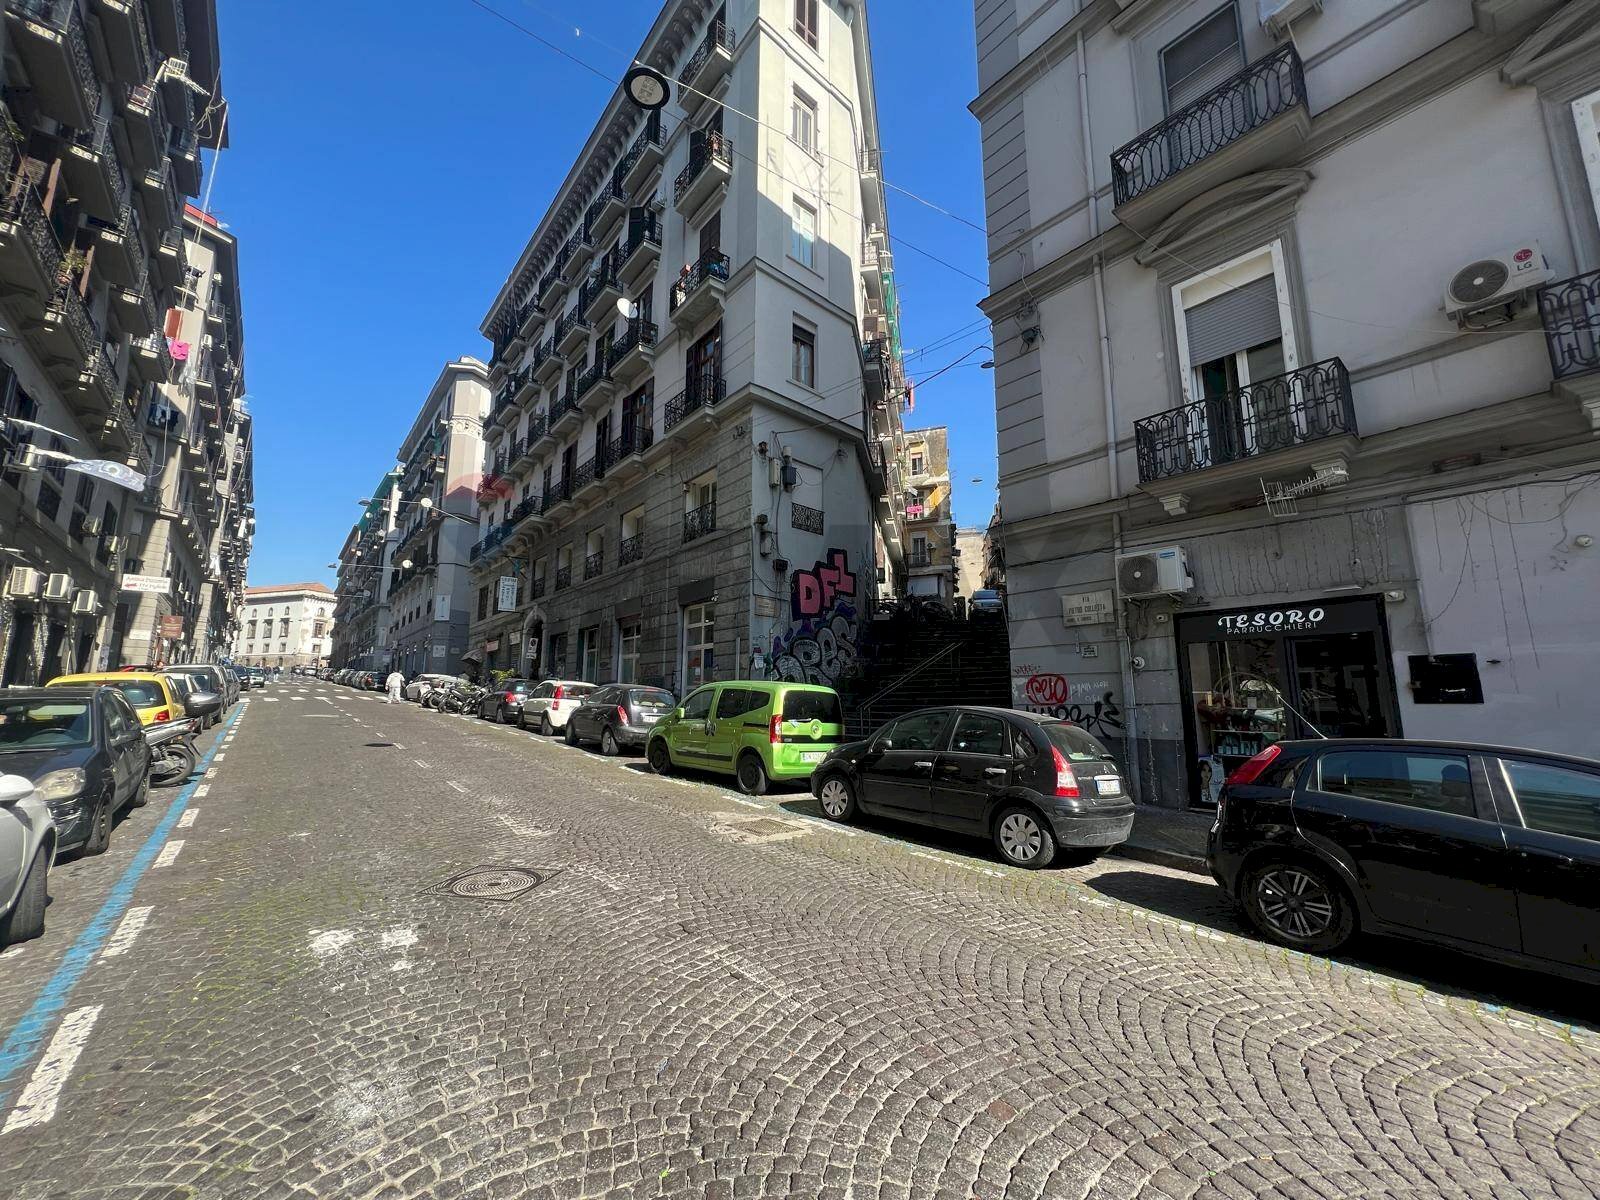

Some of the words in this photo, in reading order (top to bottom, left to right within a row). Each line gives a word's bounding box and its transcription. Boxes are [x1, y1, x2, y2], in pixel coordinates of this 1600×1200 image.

[1517, 262, 1532, 271] LG
[1217, 607, 1325, 628] TESORO
[1226, 622, 1317, 635] PARRUCCHIERI
